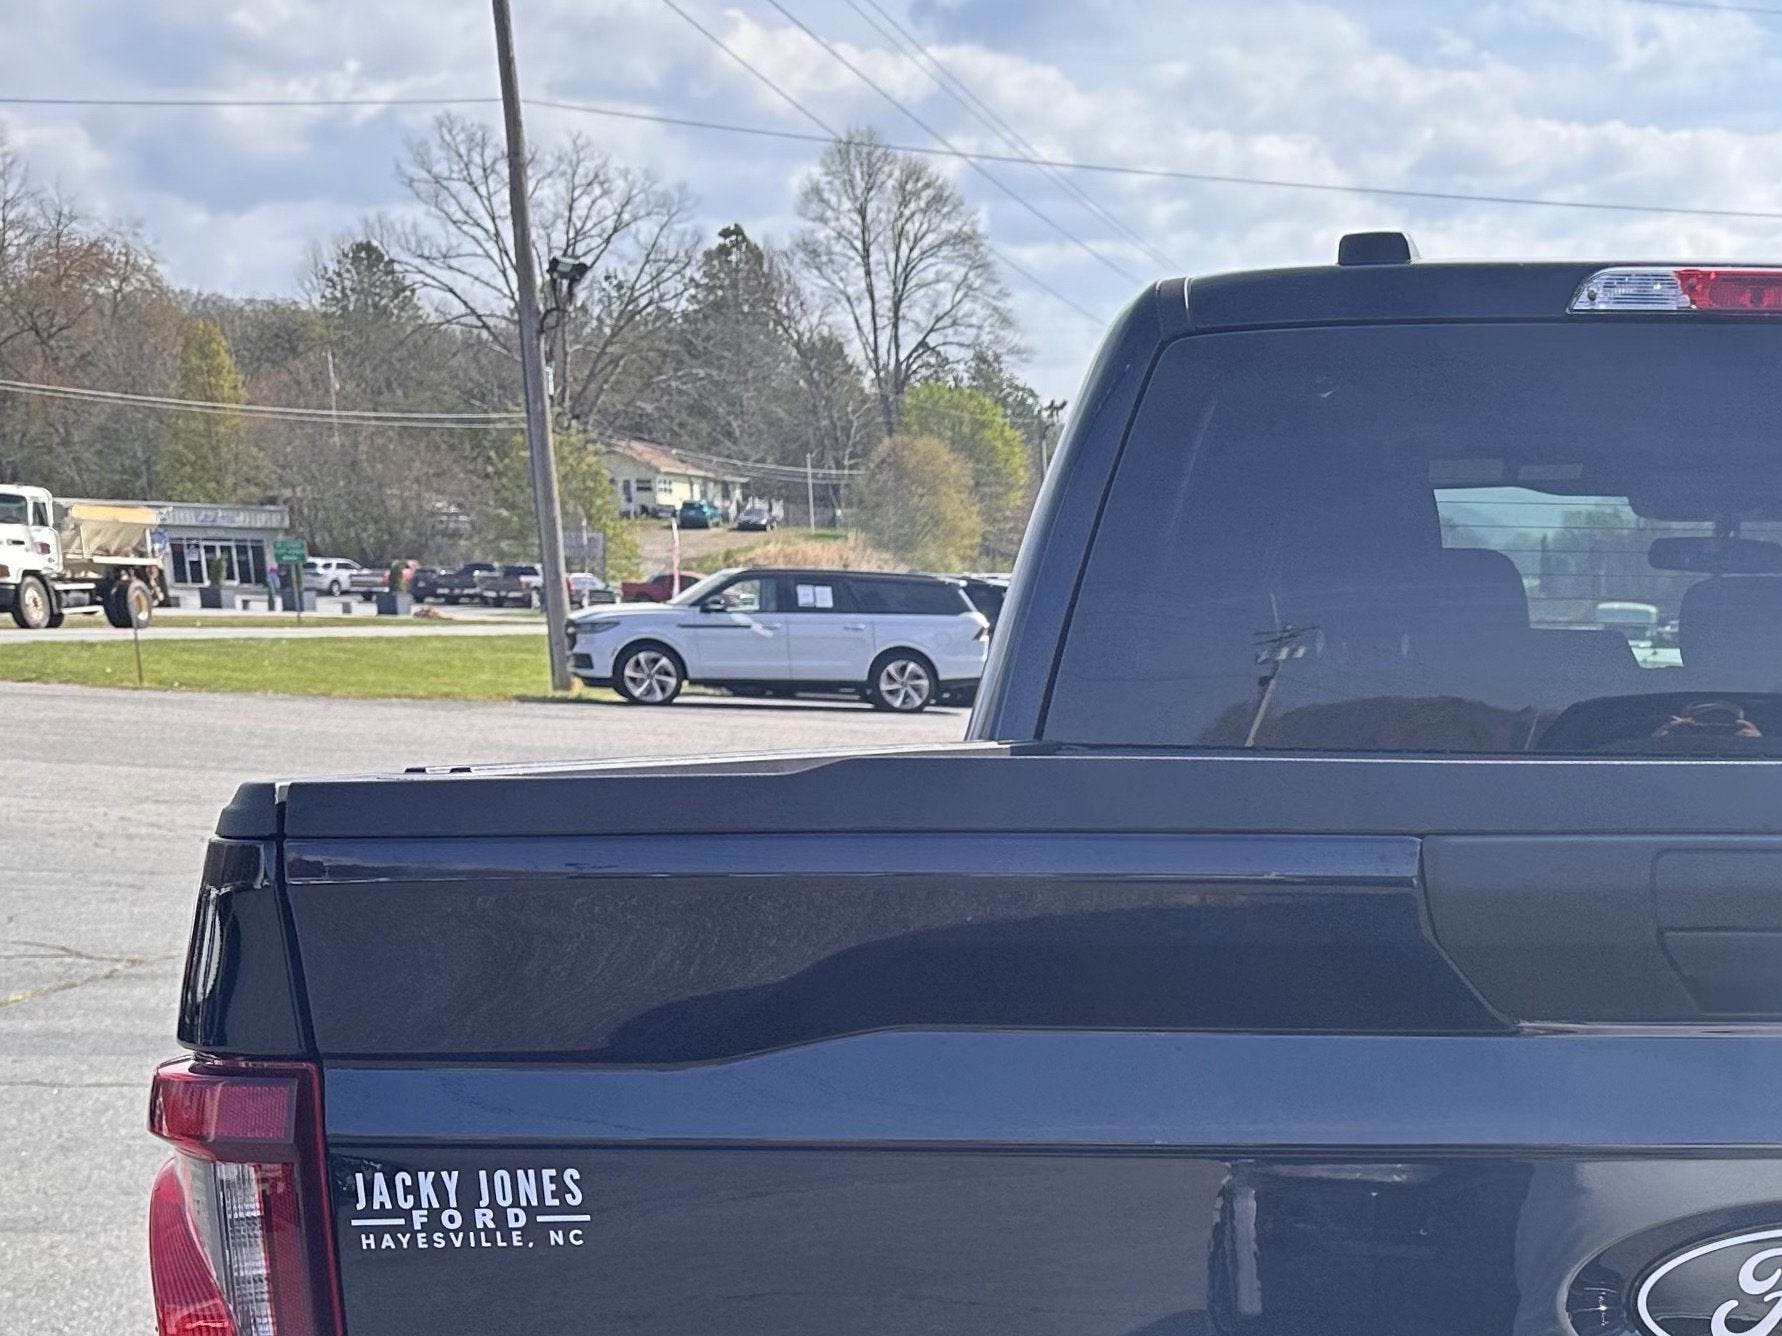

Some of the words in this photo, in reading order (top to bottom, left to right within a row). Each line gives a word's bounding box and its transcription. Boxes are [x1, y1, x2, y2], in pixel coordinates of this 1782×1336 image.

[355, 1170, 459, 1211] JACKY
[478, 1168, 583, 1208] JONES
[411, 1208, 528, 1231] FORD
[360, 1231, 535, 1250] HAYESVILLE,
[549, 1229, 584, 1246] NC
